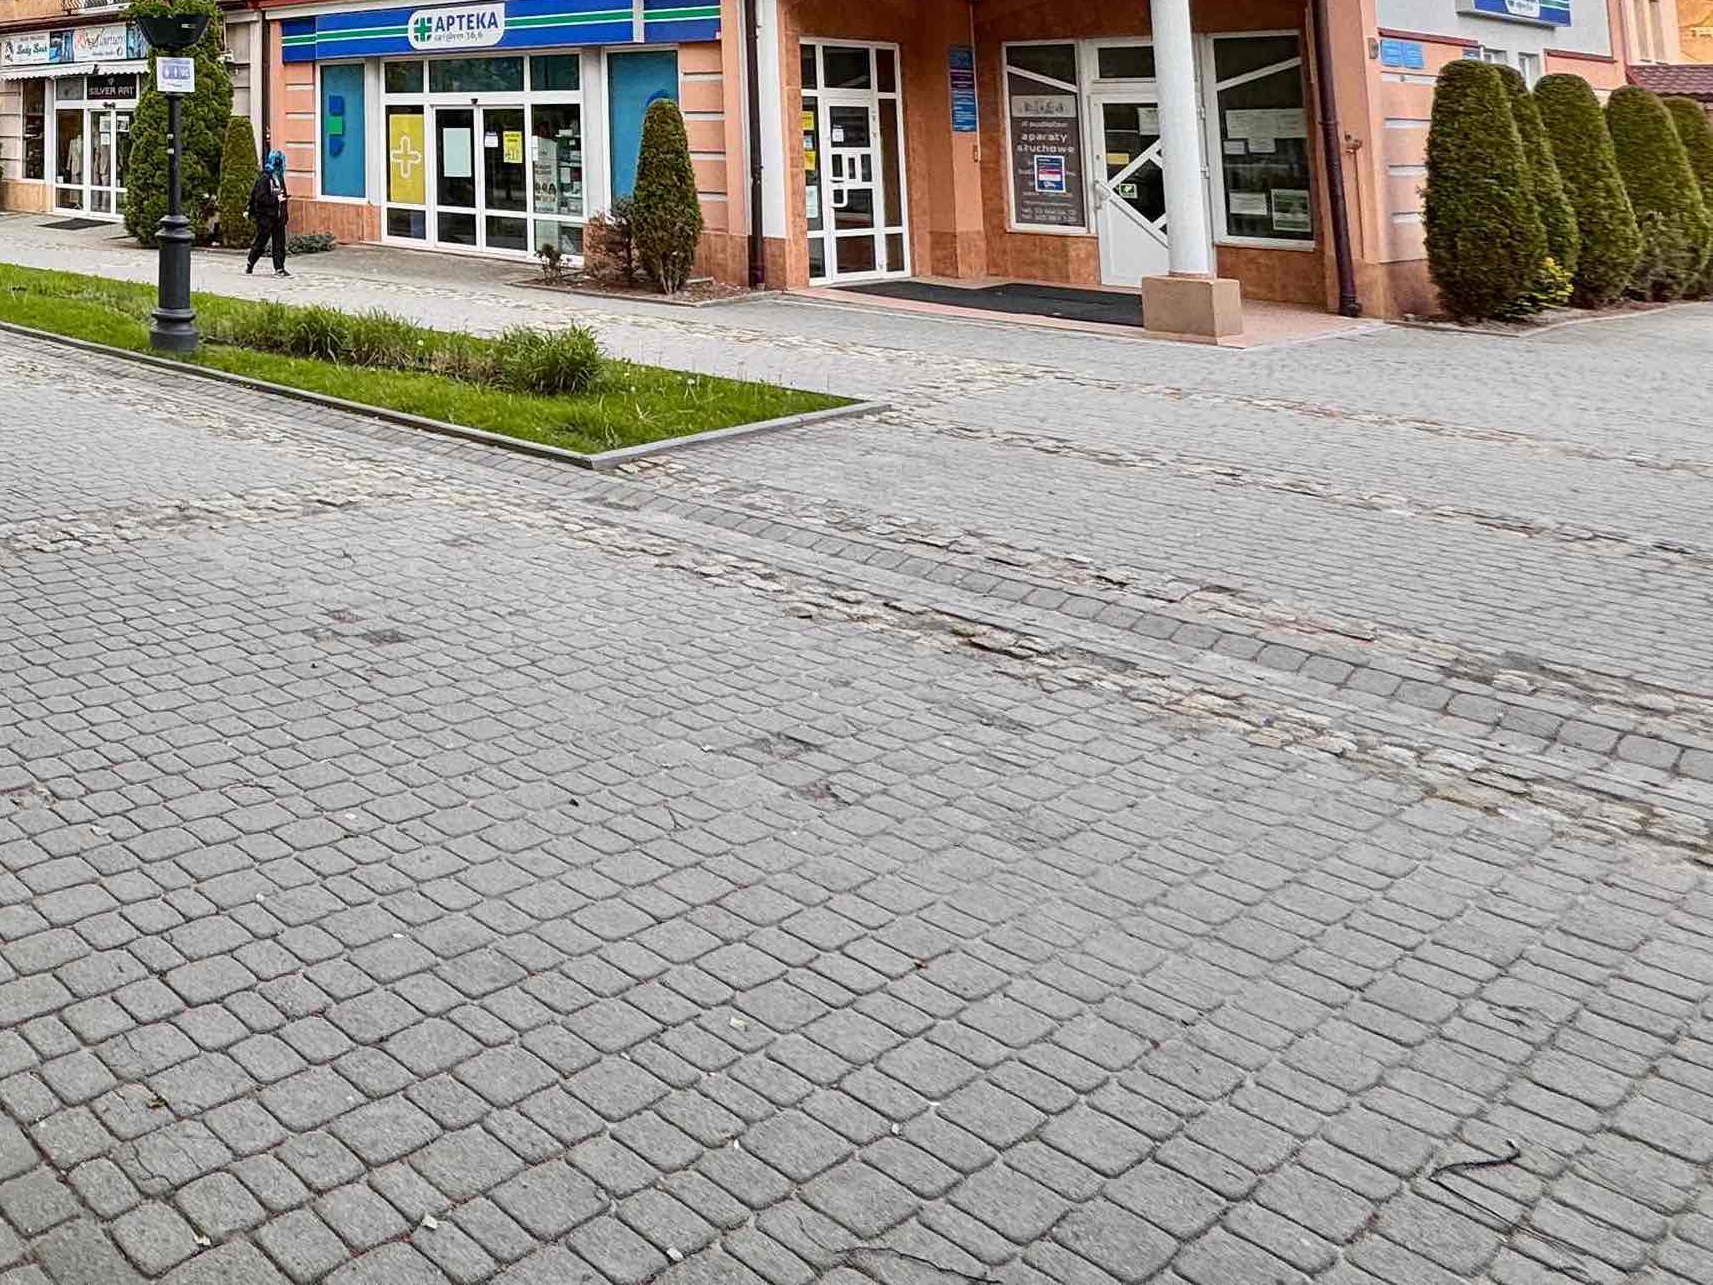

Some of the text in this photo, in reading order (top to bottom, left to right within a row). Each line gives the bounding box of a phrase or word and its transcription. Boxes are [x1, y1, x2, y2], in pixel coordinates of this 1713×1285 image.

[435, 11, 499, 32] APTEKA
[88, 86, 116, 96] SILVER
[1021, 133, 1068, 143] aparaty
[1016, 144, 1076, 153] słuchowe
